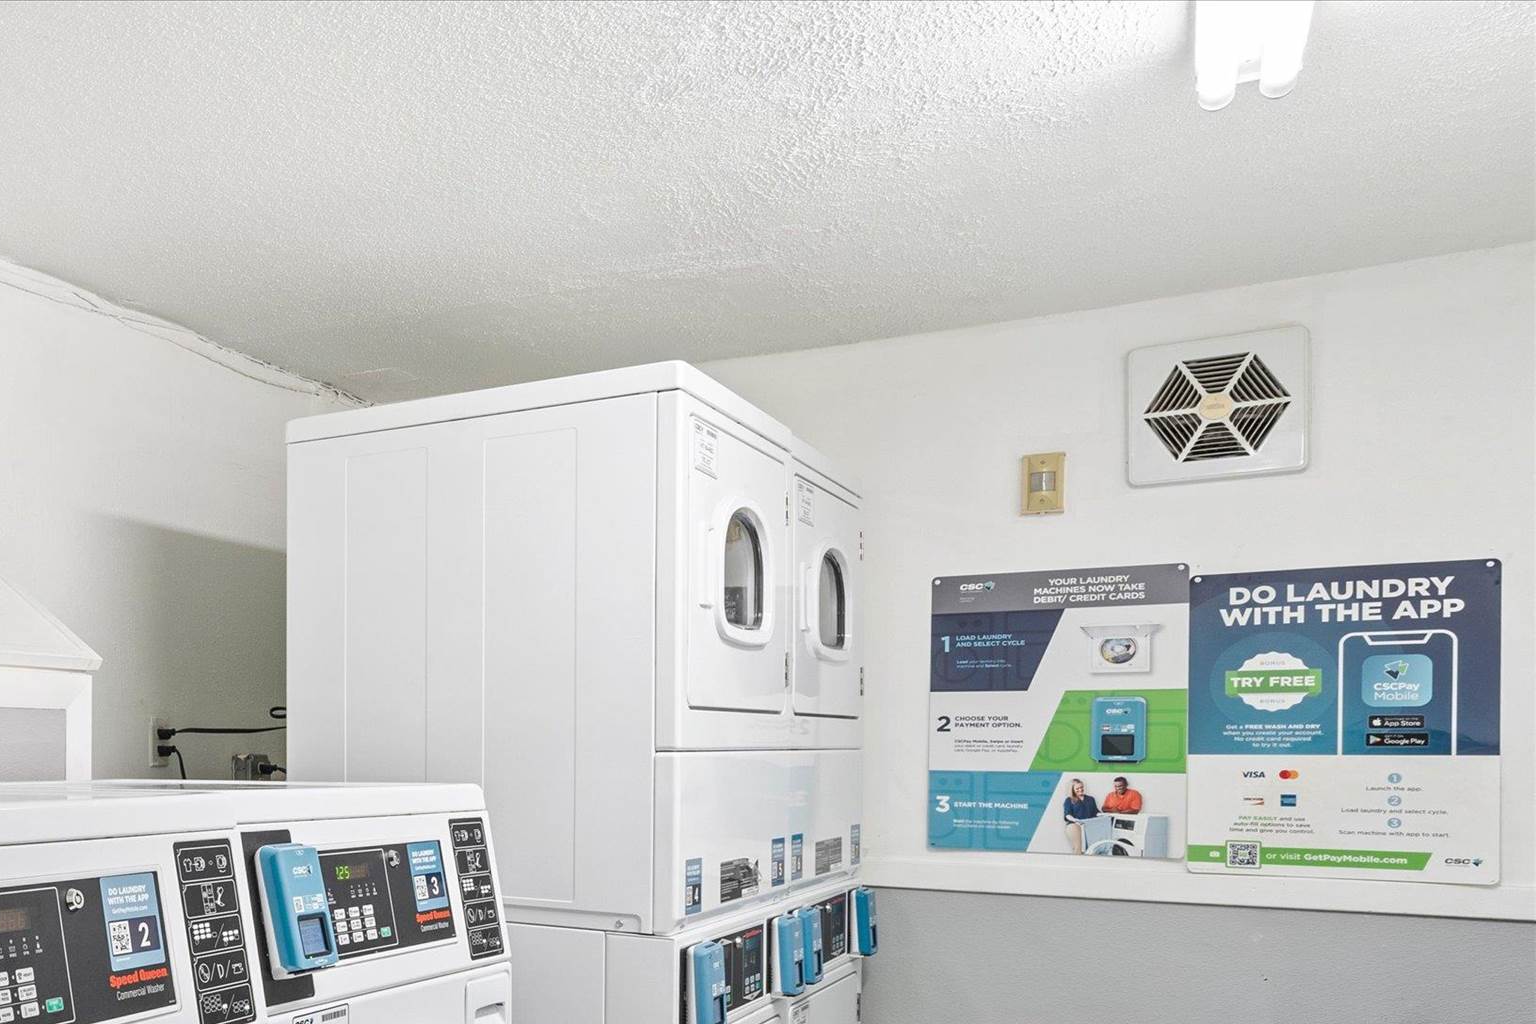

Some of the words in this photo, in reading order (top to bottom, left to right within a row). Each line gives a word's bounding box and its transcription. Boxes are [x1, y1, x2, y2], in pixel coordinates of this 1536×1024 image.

[960, 582, 983, 590] CSC
[1048, 577, 1077, 585] YOUR
[1079, 575, 1129, 584] LAUNDRY
[1033, 585, 1086, 595] MACHINES
[1088, 584, 1114, 592] NOW
[1117, 582, 1145, 591] TAKE
[1229, 585, 1276, 605] DO
[1287, 575, 1454, 602] LAUNDRY
[1033, 594, 1064, 604] DEBIT/
[1069, 592, 1106, 602] CREDIT
[1108, 591, 1145, 600] CARDS
[1219, 605, 1304, 626] WITH
[1315, 601, 1382, 622] THE
[1391, 598, 1465, 619] APP
[941, 636, 949, 652] 1
[1230, 677, 1264, 687] TRY
[1269, 676, 1315, 687] FREE
[1373, 682, 1419, 691] CSCPay
[1374, 690, 1418, 700] Mobile
[936, 715, 950, 731] 2
[935, 795, 949, 811] 3
[1279, 851, 1300, 860] visit
[1303, 851, 1407, 866] GetPayMobile.com
[107, 887, 117, 895] DO
[118, 884, 146, 894] LAUNDRY
[430, 875, 439, 894] 3
[107, 896, 124, 905] WITH
[125, 895, 137, 903] THE
[137, 893, 149, 901] APP
[137, 921, 150, 946] 2
[110, 969, 139, 988] Speed
[140, 966, 168, 982] Queen
[117, 985, 146, 1001] Commercial
[147, 982, 165, 995] Washer
